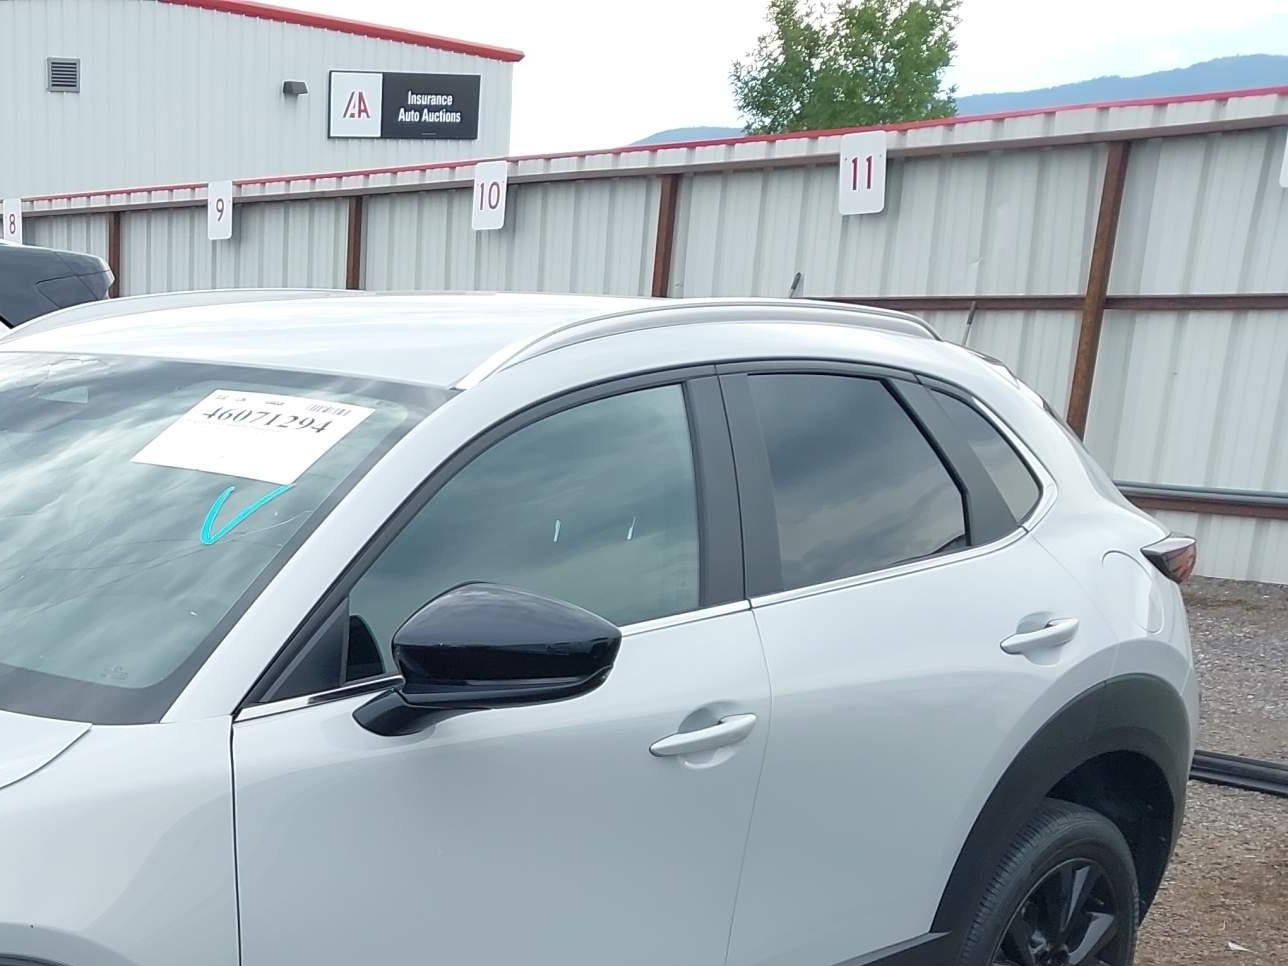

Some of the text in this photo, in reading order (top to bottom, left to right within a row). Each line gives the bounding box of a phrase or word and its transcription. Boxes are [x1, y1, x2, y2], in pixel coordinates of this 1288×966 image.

[407, 90, 453, 106] Insurance
[398, 107, 461, 123] Auto Auctions
[852, 155, 872, 191] 11
[480, 181, 500, 210] 10
[216, 198, 225, 221] 9
[9, 213, 16, 234] 8
[202, 406, 333, 433] 46071294
